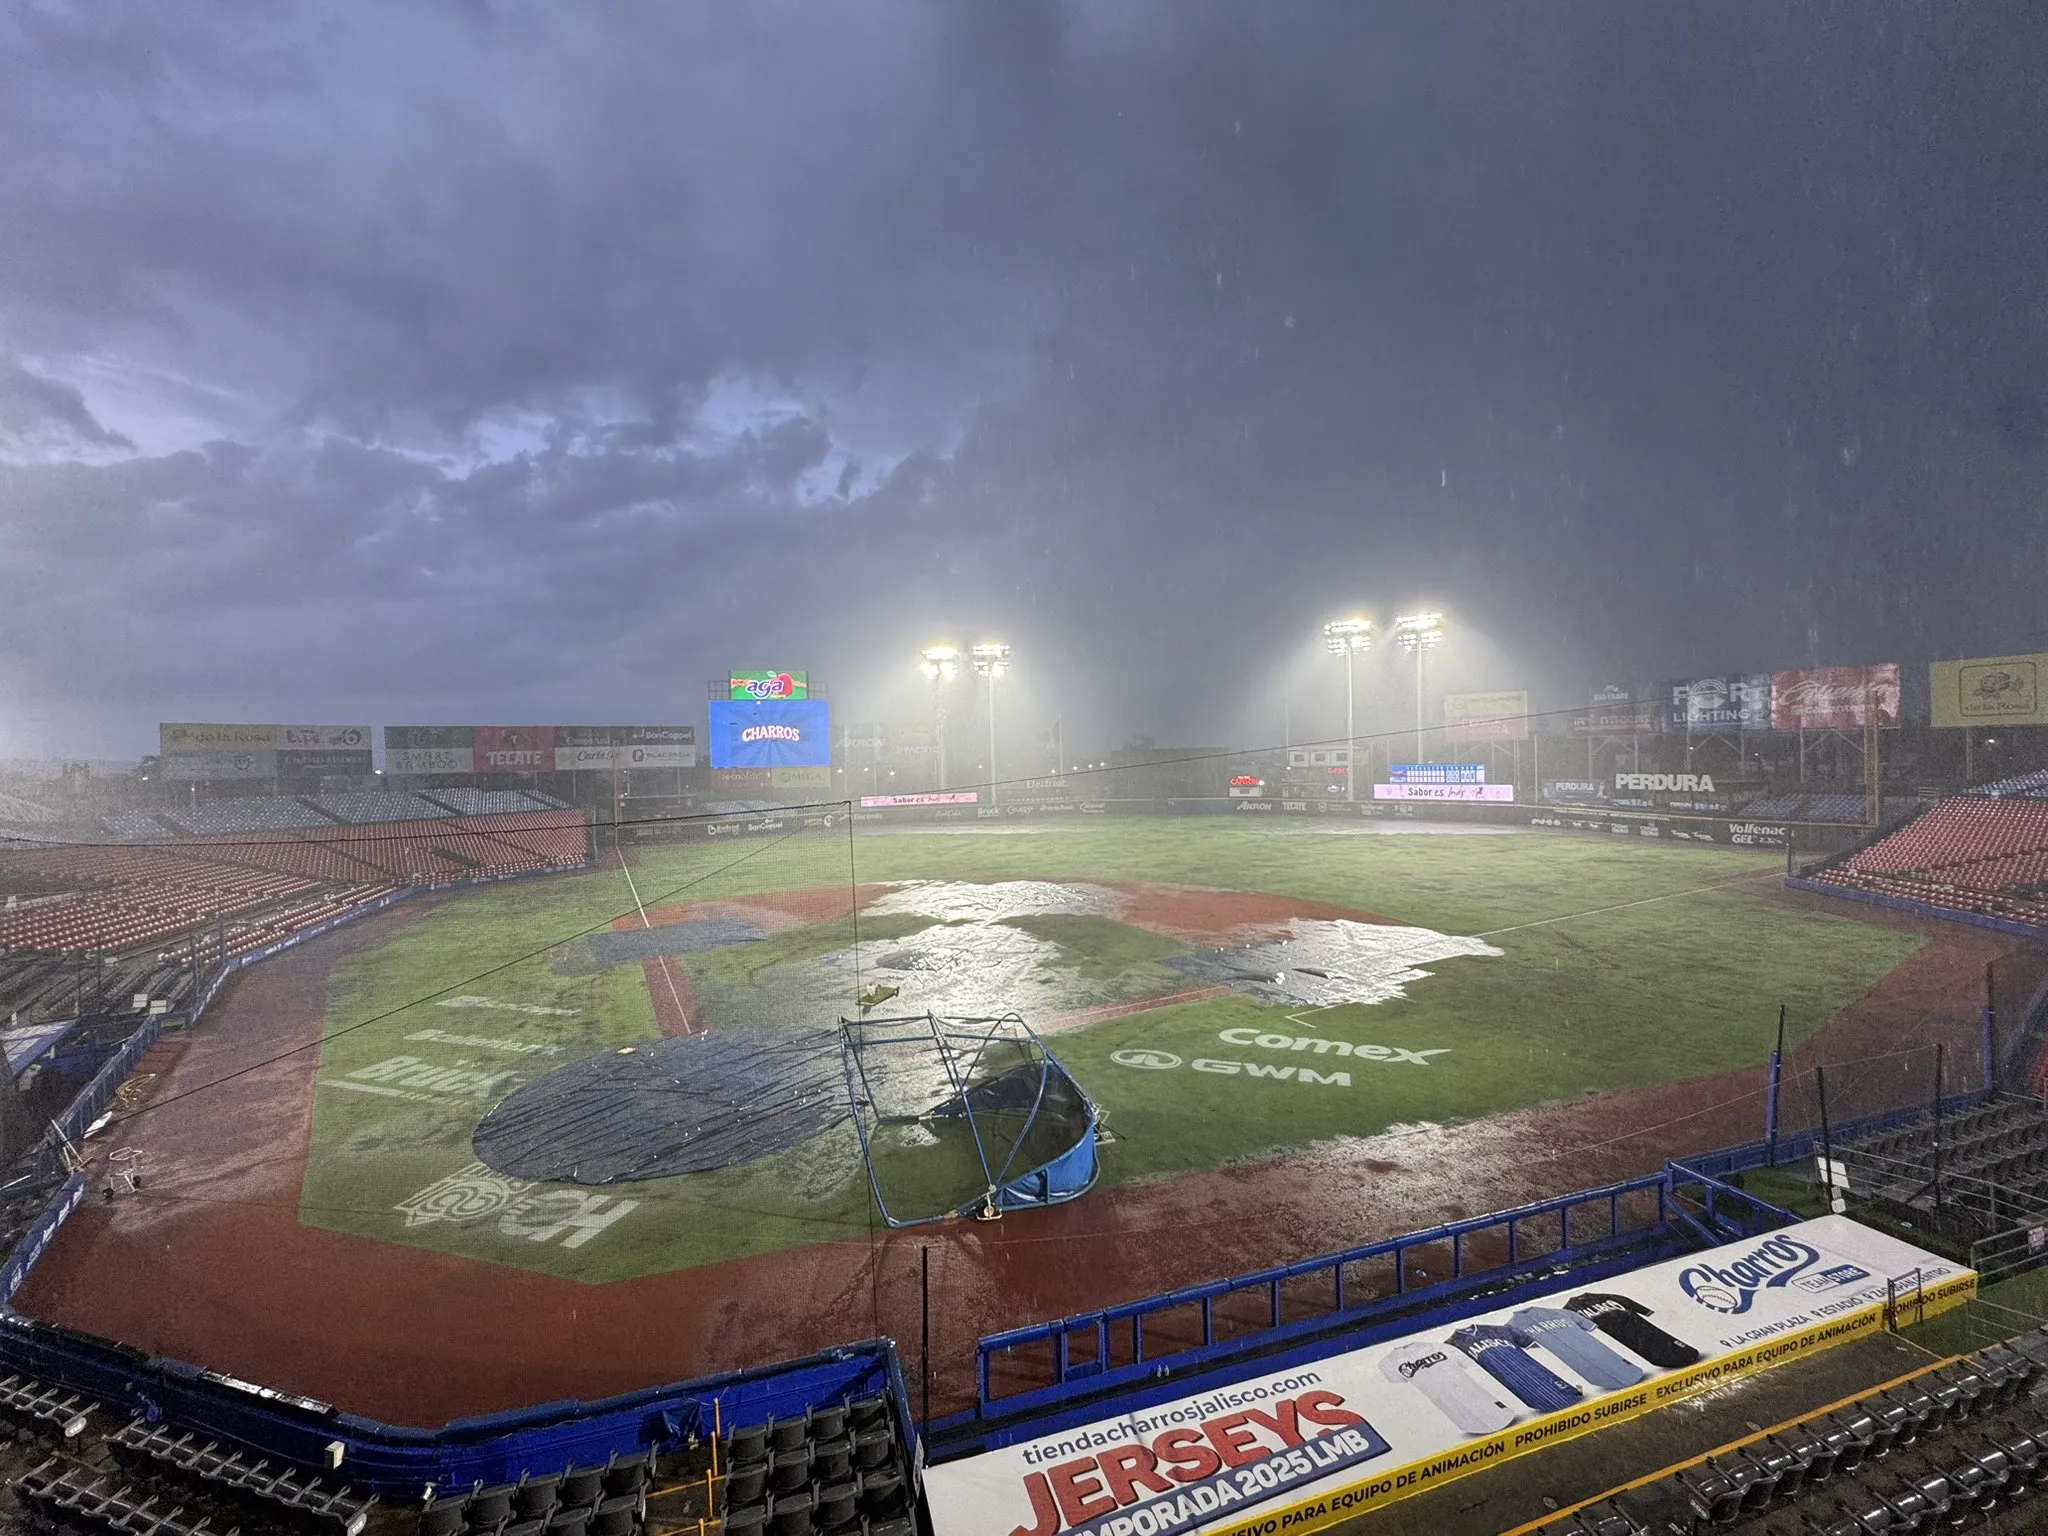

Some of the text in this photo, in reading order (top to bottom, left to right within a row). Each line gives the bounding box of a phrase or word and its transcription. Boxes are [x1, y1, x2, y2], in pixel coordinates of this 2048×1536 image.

[746, 680, 784, 698] aga
[1673, 709, 1750, 722] LIGHTING
[742, 725, 800, 742] CHARROS
[403, 751, 449, 761] SMART
[486, 750, 543, 765] TECATE
[396, 760, 458, 771] BAMBOO
[1408, 787, 1432, 797] Sabor
[1434, 789, 1444, 797] es
[1555, 782, 1595, 791] PERDURA
[1615, 773, 1716, 793] PERDURA
[1237, 801, 1272, 810] AKRON
[1283, 802, 1308, 811] TECATE
[1729, 823, 1786, 836] Volfenac
[1731, 834, 1754, 845] GEL
[1218, 1028, 1452, 1066] Comex
[1191, 1059, 1353, 1088] GWM
[1679, 1234, 1820, 1315] Charros
[1800, 1266, 1866, 1291] TEAM STORE
[1731, 1333, 1745, 1347] LA
[1743, 1323, 1776, 1341] GRAN
[1775, 1314, 1809, 1333] PLAZA
[1817, 1297, 1865, 1319] ESTADIO
[1869, 1277, 1915, 1298] ZAPAN
[1399, 1350, 1446, 1379] Charros
[1282, 1502, 1327, 1528] PARA
[1331, 1482, 1392, 1511] EQUIPO
[1396, 1470, 1417, 1489] DE
[1420, 1441, 1505, 1481] ANIMACIÓN
[1515, 1411, 1591, 1449] PROHIBIDO
[1593, 1393, 1647, 1421] SUBIRSE
[1655, 1366, 1721, 1400] EXCLUSIVO
[1723, 1355, 1754, 1377] PARA
[1756, 1341, 1799, 1366] EQUIPO
[1799, 1333, 1816, 1349] DE
[1817, 1312, 1877, 1345] ANIMACIÓN
[1884, 1292, 1936, 1317] OHIBDO
[1938, 1278, 1976, 1300] SUBIRSE
[1022, 1368, 1323, 1467] tiendacharrosjalisco.com
[1008, 1390, 1366, 1536] JERSEYS
[1235, 1448, 1312, 1497] 2025
[1308, 1428, 1370, 1468] LMB
